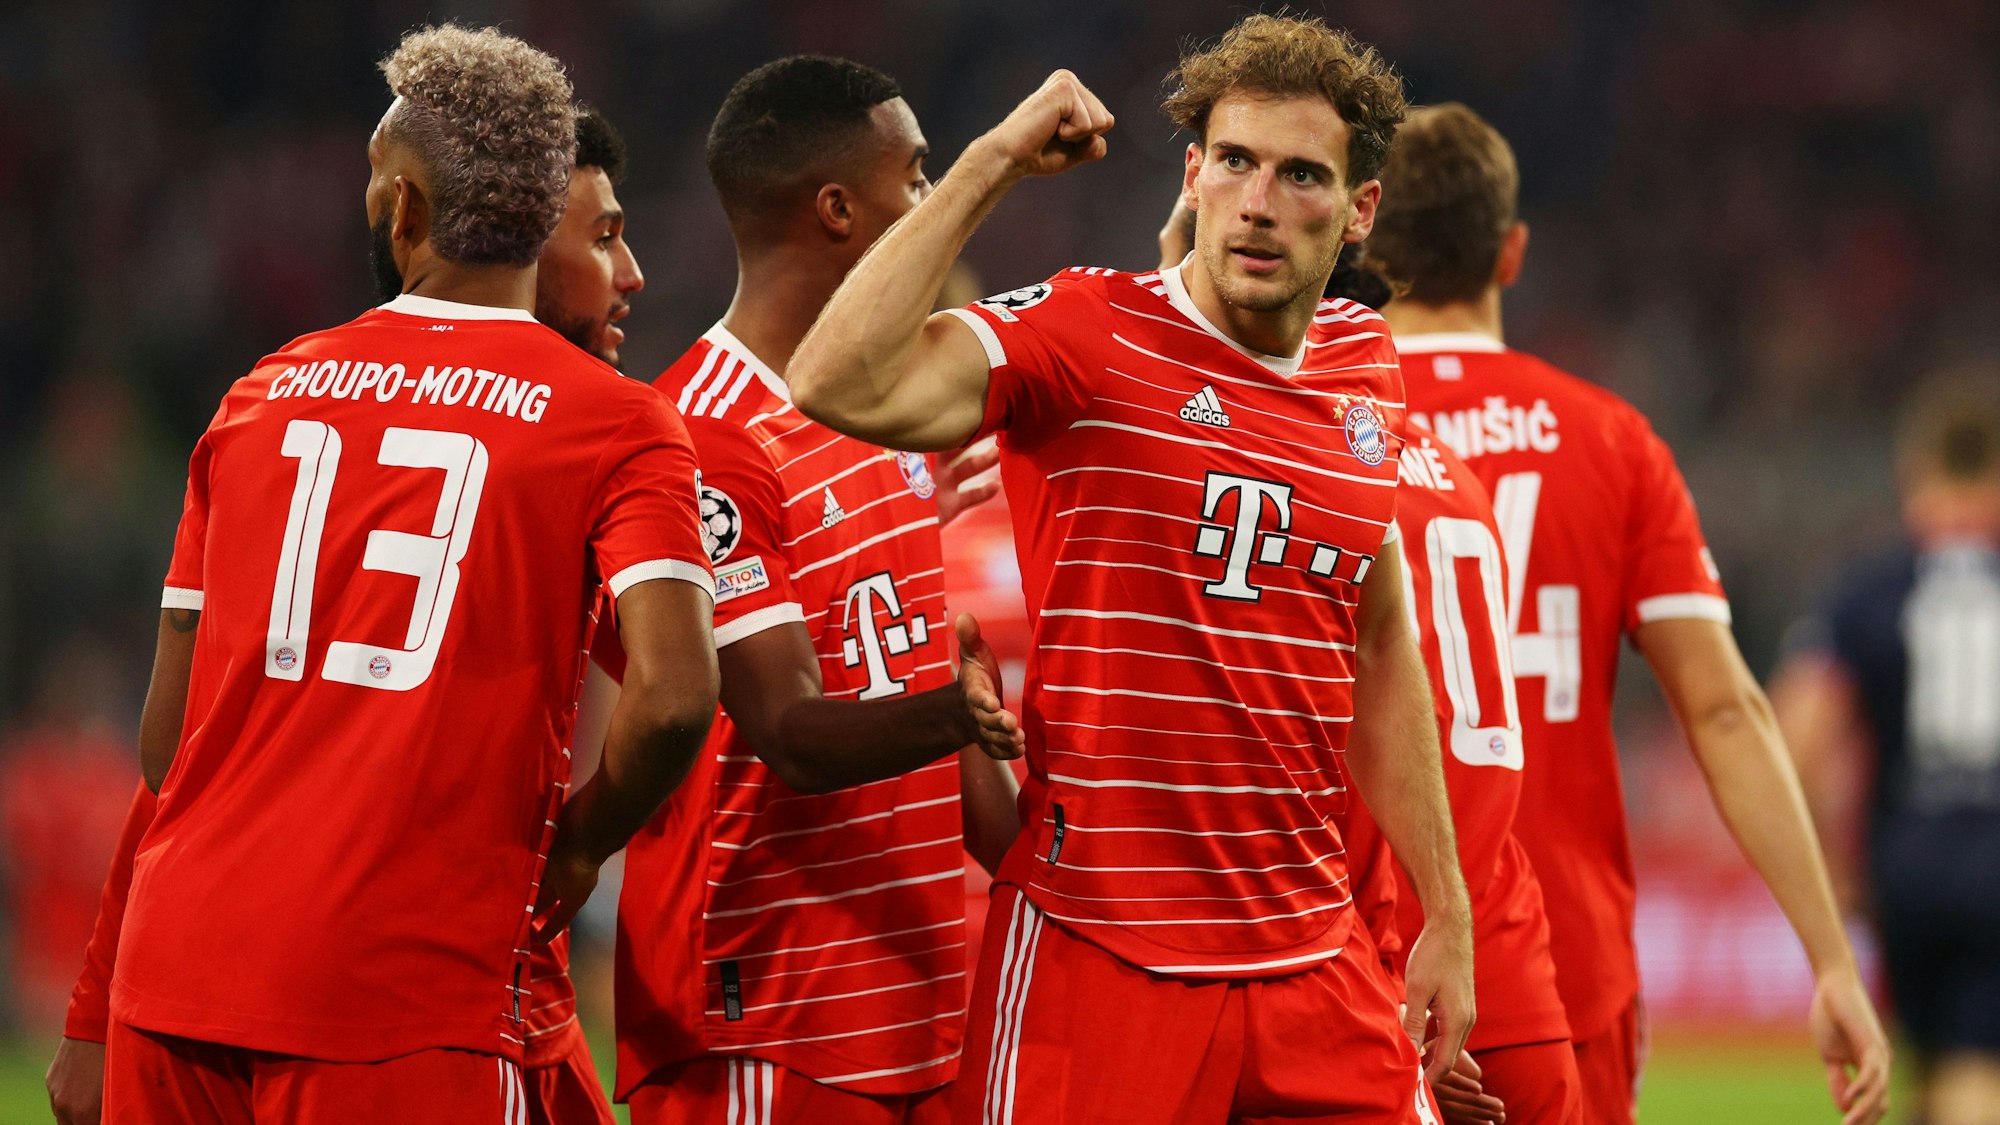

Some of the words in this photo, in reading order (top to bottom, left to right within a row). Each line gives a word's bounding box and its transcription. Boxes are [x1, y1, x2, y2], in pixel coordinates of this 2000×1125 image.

[266, 359, 552, 424] CHOUPO-MOTING
[1179, 407, 1231, 427] adidas
[265, 419, 489, 692] 13
[1201, 470, 1294, 602] T
